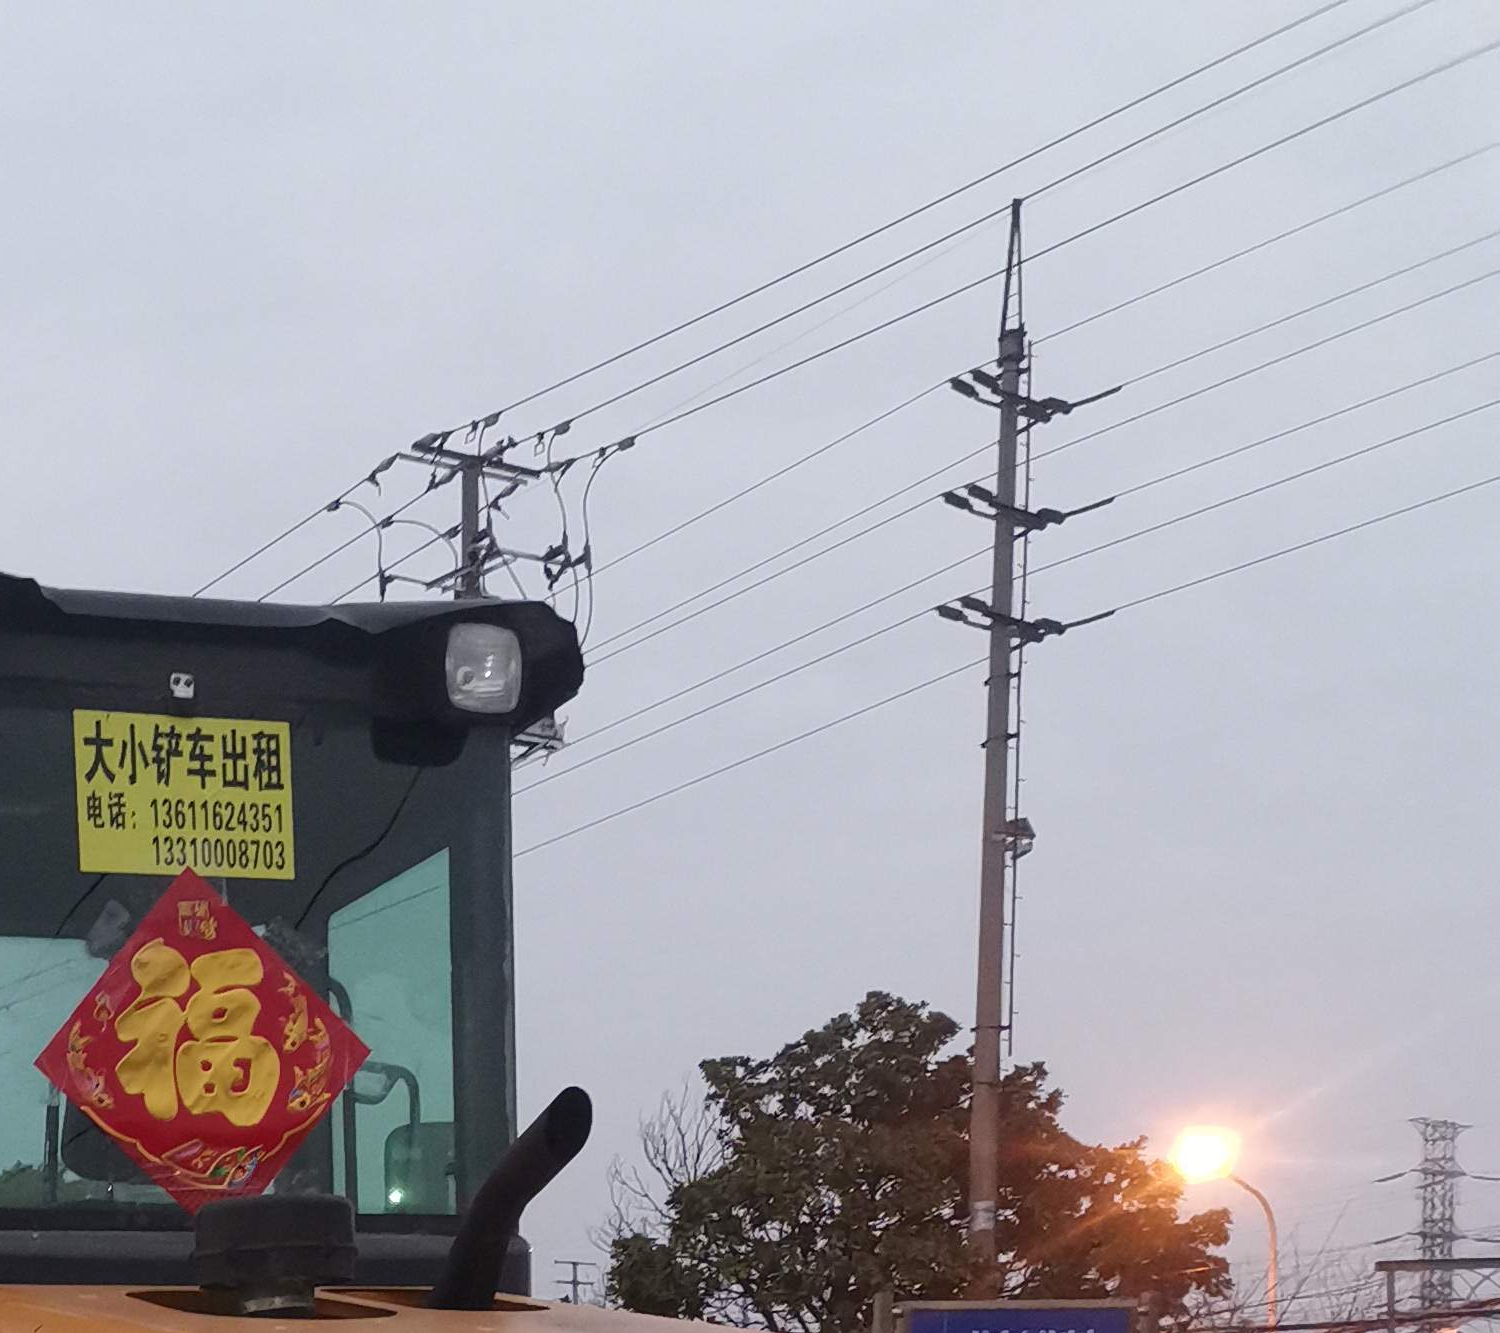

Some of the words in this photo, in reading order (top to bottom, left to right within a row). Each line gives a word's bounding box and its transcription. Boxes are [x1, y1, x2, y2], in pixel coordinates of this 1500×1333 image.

[83, 720, 284, 791] 大小铲车出租
[150, 798, 284, 834] 13611624351
[151, 835, 286, 871] 13310008703
[114, 937, 281, 1127] 福
